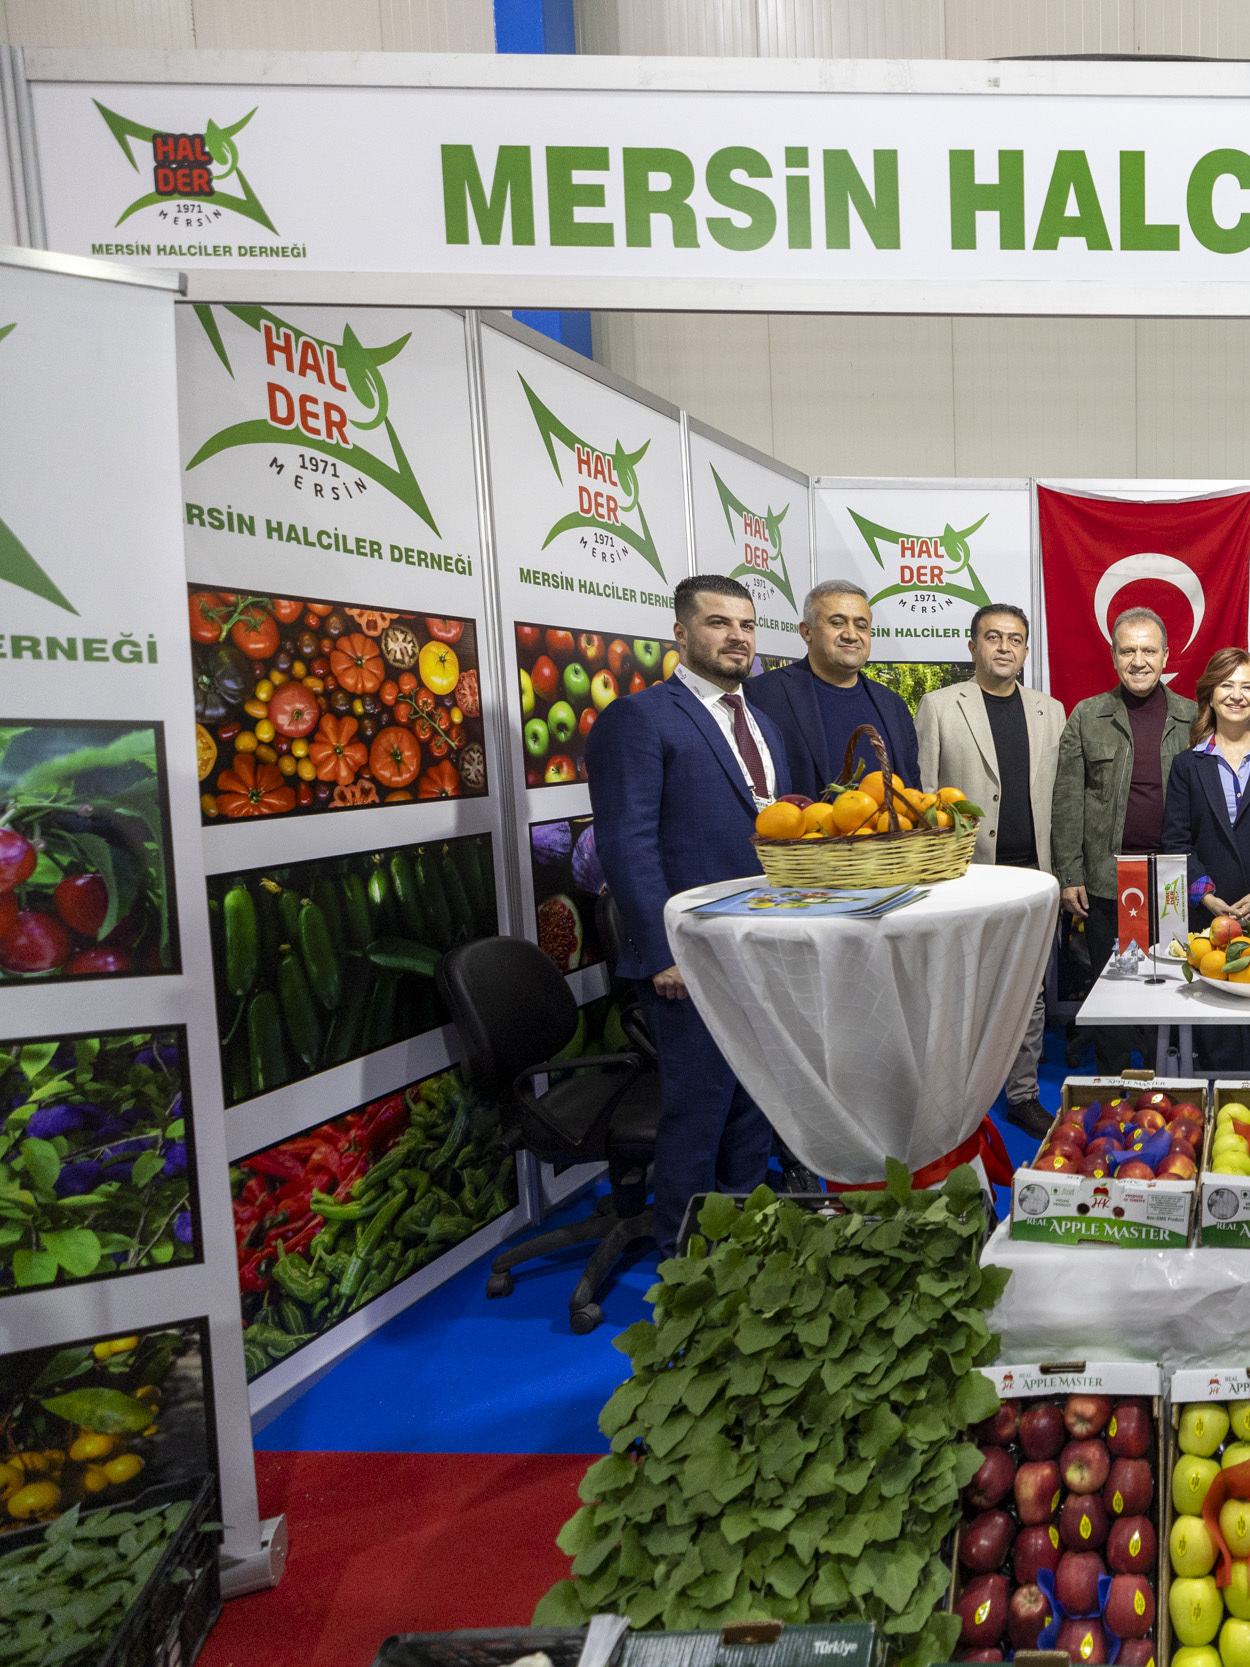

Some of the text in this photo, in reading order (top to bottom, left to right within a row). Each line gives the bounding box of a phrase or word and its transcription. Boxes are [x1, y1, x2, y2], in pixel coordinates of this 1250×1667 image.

[155, 137, 210, 161] HAL
[157, 168, 211, 192] DER
[176, 204, 203, 213] 1971
[91, 241, 307, 258] MERSİN HALCİLER DERNEĞİ
[263, 323, 347, 392] HAL
[267, 381, 350, 446] DER
[298, 454, 340, 478] 1971
[576, 446, 618, 487] HAL
[578, 485, 619, 524] DER
[185, 502, 473, 576] RSİN HALCİLER DERNEĞİ
[594, 532, 614, 547] 1971
[743, 513, 769, 542] HAL
[744, 542, 769, 570] DER
[900, 539, 944, 558] HAL
[753, 578, 766, 589] 1971
[900, 565, 945, 584] DER
[519, 567, 675, 610] MERSİN HALCİLER DERNE
[914, 594, 937, 602] 1971
[781, 621, 799, 634] DERN
[870, 625, 890, 638] SİN
[895, 625, 960, 638] HALCİLER
[0, 632, 158, 664] RNEĞİ
[1026, 1217, 1170, 1241] REAL APPLE MASTER
[1216, 1221, 1238, 1231] REAL
[1023, 1376, 1103, 1391] APPLE MASTER
[814, 1639, 858, 1657] Türkiye
